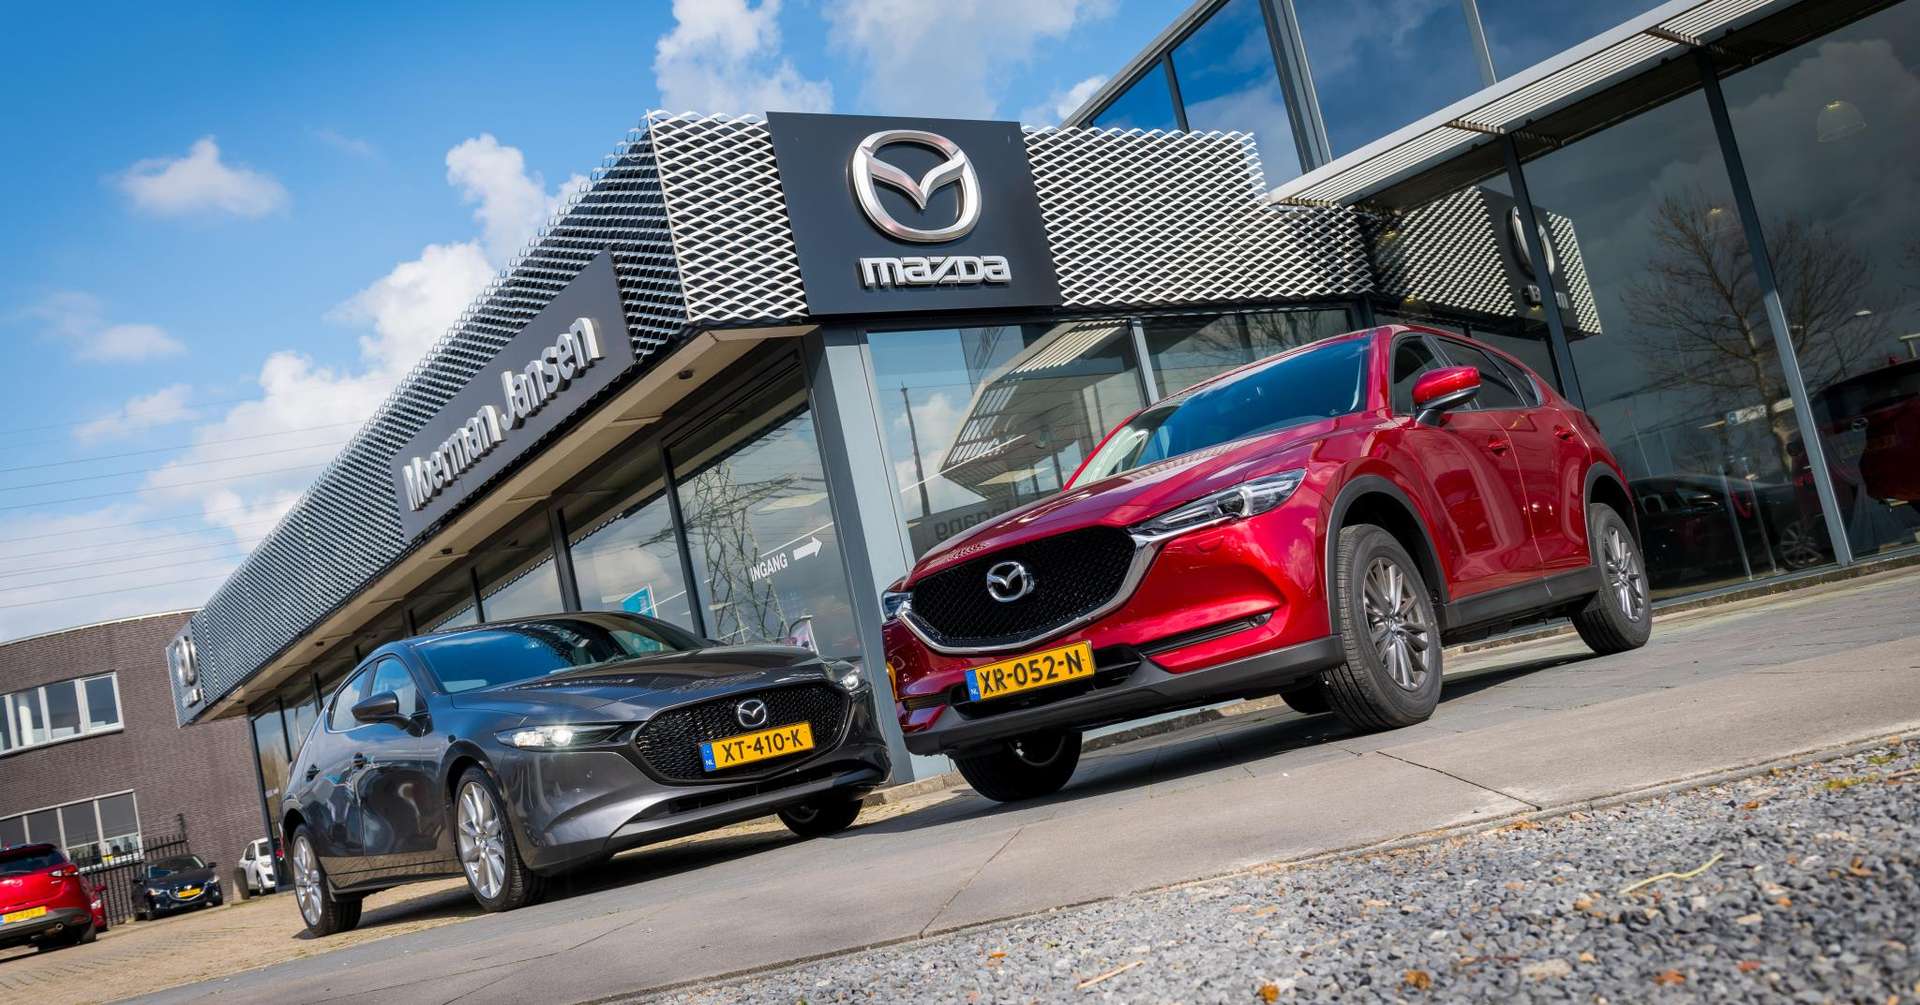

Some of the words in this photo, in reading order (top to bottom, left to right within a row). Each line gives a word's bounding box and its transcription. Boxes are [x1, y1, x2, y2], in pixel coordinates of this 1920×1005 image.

[402, 405, 502, 511] Moerman
[500, 317, 600, 431] Jansen
[750, 552, 788, 582] INGANG
[980, 650, 1083, 694] XR-052-N
[721, 729, 803, 762] XT-410-K
